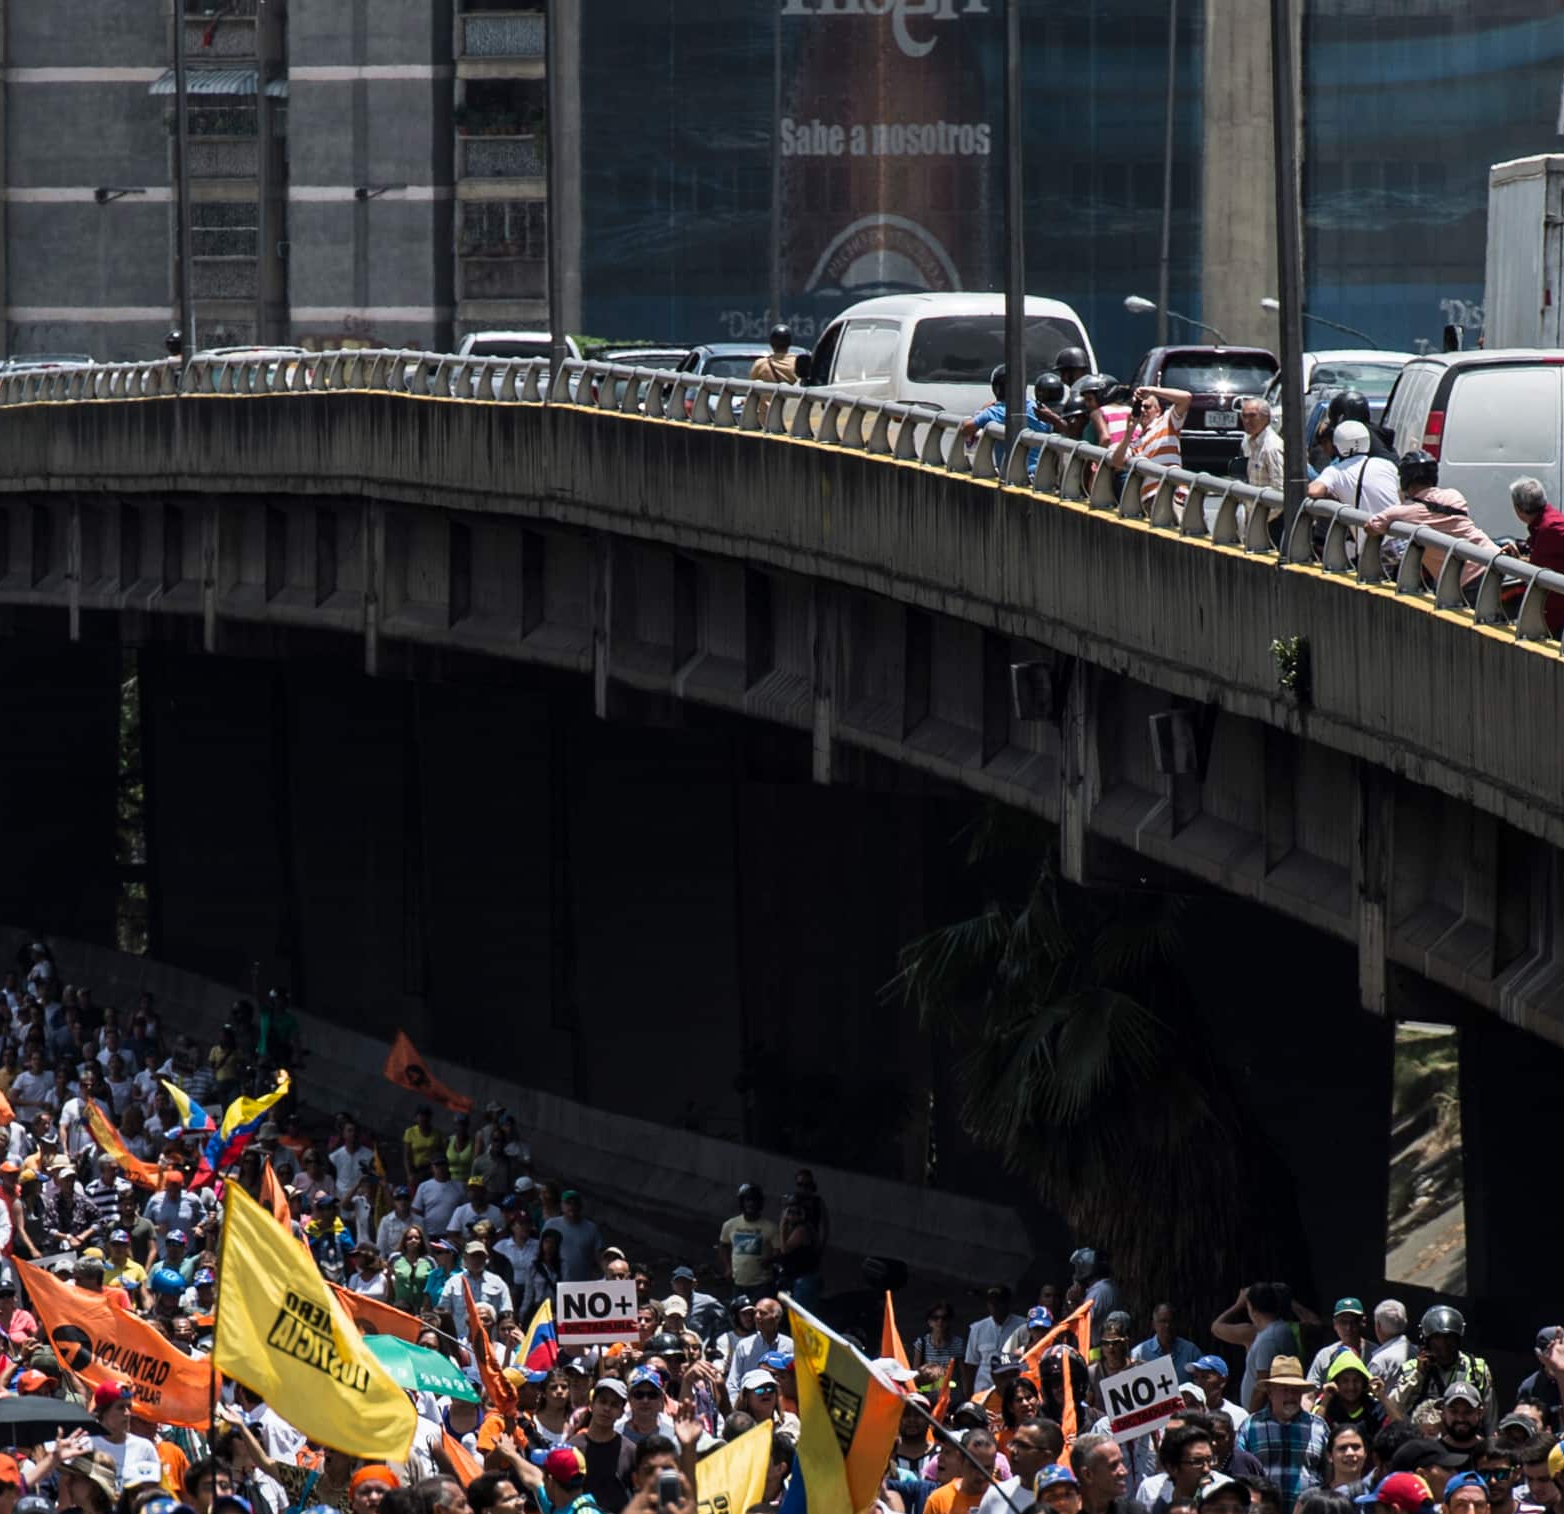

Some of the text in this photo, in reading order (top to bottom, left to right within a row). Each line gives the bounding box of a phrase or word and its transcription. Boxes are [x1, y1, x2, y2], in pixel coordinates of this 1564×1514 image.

[780, 118, 992, 156] Sabe a nosotros
[563, 1290, 633, 1319] NO+
[92, 1339, 172, 1386] VOLUNTAD
[1108, 1373, 1174, 1416] NO+
